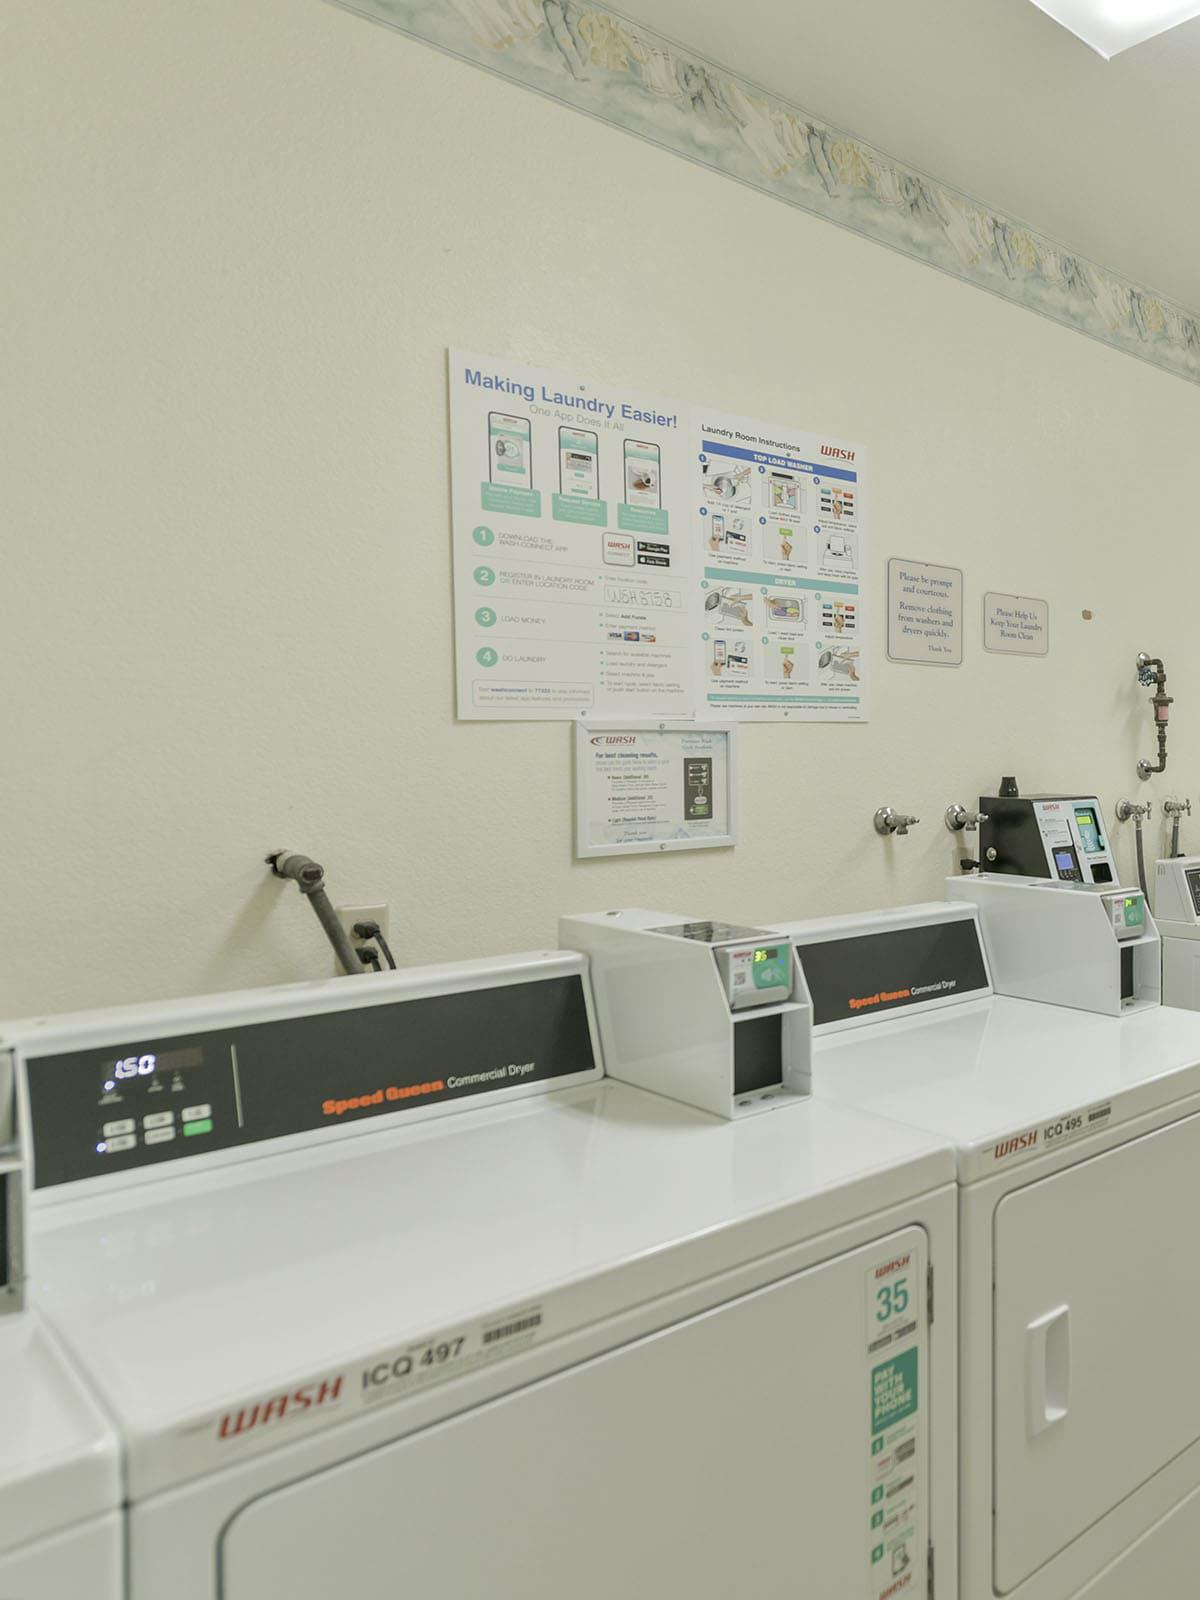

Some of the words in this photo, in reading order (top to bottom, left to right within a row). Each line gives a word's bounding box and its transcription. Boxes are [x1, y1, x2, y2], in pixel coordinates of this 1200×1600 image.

[464, 368, 535, 401] Making
[541, 387, 615, 418] Laundry
[621, 404, 678, 429] Easier!
[529, 404, 551, 417] One
[553, 410, 574, 423] App
[577, 415, 601, 428] Does
[613, 422, 625, 432] All
[701, 424, 733, 439] Laundry
[735, 432, 758, 443] Room
[758, 436, 801, 452] Instructions
[820, 444, 856, 461] WASH
[753, 454, 767, 463] TOP
[768, 457, 786, 467] LOAD
[787, 461, 814, 473] WASHER
[479, 530, 486, 541] 1
[498, 532, 539, 544] DOWNLOAD
[499, 539, 520, 547] WASH
[521, 542, 554, 551] CONNECT
[607, 541, 631, 550] WASH
[479, 571, 489, 581] 2
[499, 571, 533, 579] REGISTER
[542, 576, 574, 584] LAUNDRY
[774, 578, 797, 586] DRYER
[899, 572, 920, 584] Please
[921, 576, 929, 585] be
[930, 579, 953, 589] prompt
[512, 579, 534, 587] ENTER
[536, 582, 569, 590] LOCATION
[569, 584, 588, 592] CODE
[902, 586, 915, 594] and
[916, 588, 950, 599] courteous.
[899, 602, 926, 612] Remove
[927, 606, 953, 617] clothing
[996, 608, 1013, 618] Please
[1014, 610, 1029, 621] Help
[481, 611, 491, 622] 3
[524, 617, 547, 625] MONEY
[898, 614, 914, 624] from
[915, 617, 941, 627] washers
[942, 619, 954, 628] and
[990, 618, 1005, 628] Keep
[1006, 620, 1019, 630] Your
[1020, 622, 1042, 632] Laundry
[902, 626, 923, 637] dryers
[924, 628, 950, 639] quickly.
[1000, 629, 1017, 639] Room
[1018, 631, 1034, 641] Clean
[482, 652, 492, 663] 4
[605, 736, 637, 744] WASH
[617, 752, 639, 760] cleaning
[848, 993, 880, 1009] Speed
[880, 989, 910, 1002] Queen
[910, 983, 942, 996] Commercial
[942, 980, 957, 990] Dryer
[322, 1090, 384, 1115] Speed
[386, 1080, 444, 1101] Queen
[447, 1066, 506, 1089] Commercial
[508, 1062, 535, 1078] Dryer
[994, 1129, 1038, 1159] WASH
[1043, 1123, 1063, 1140] ICQ
[1065, 1115, 1083, 1131] 495
[875, 1254, 911, 1280] WASH
[876, 1277, 909, 1323] 35
[217, 1375, 345, 1440] WASH
[362, 1356, 415, 1390] ICQ
[420, 1337, 467, 1366] 497
